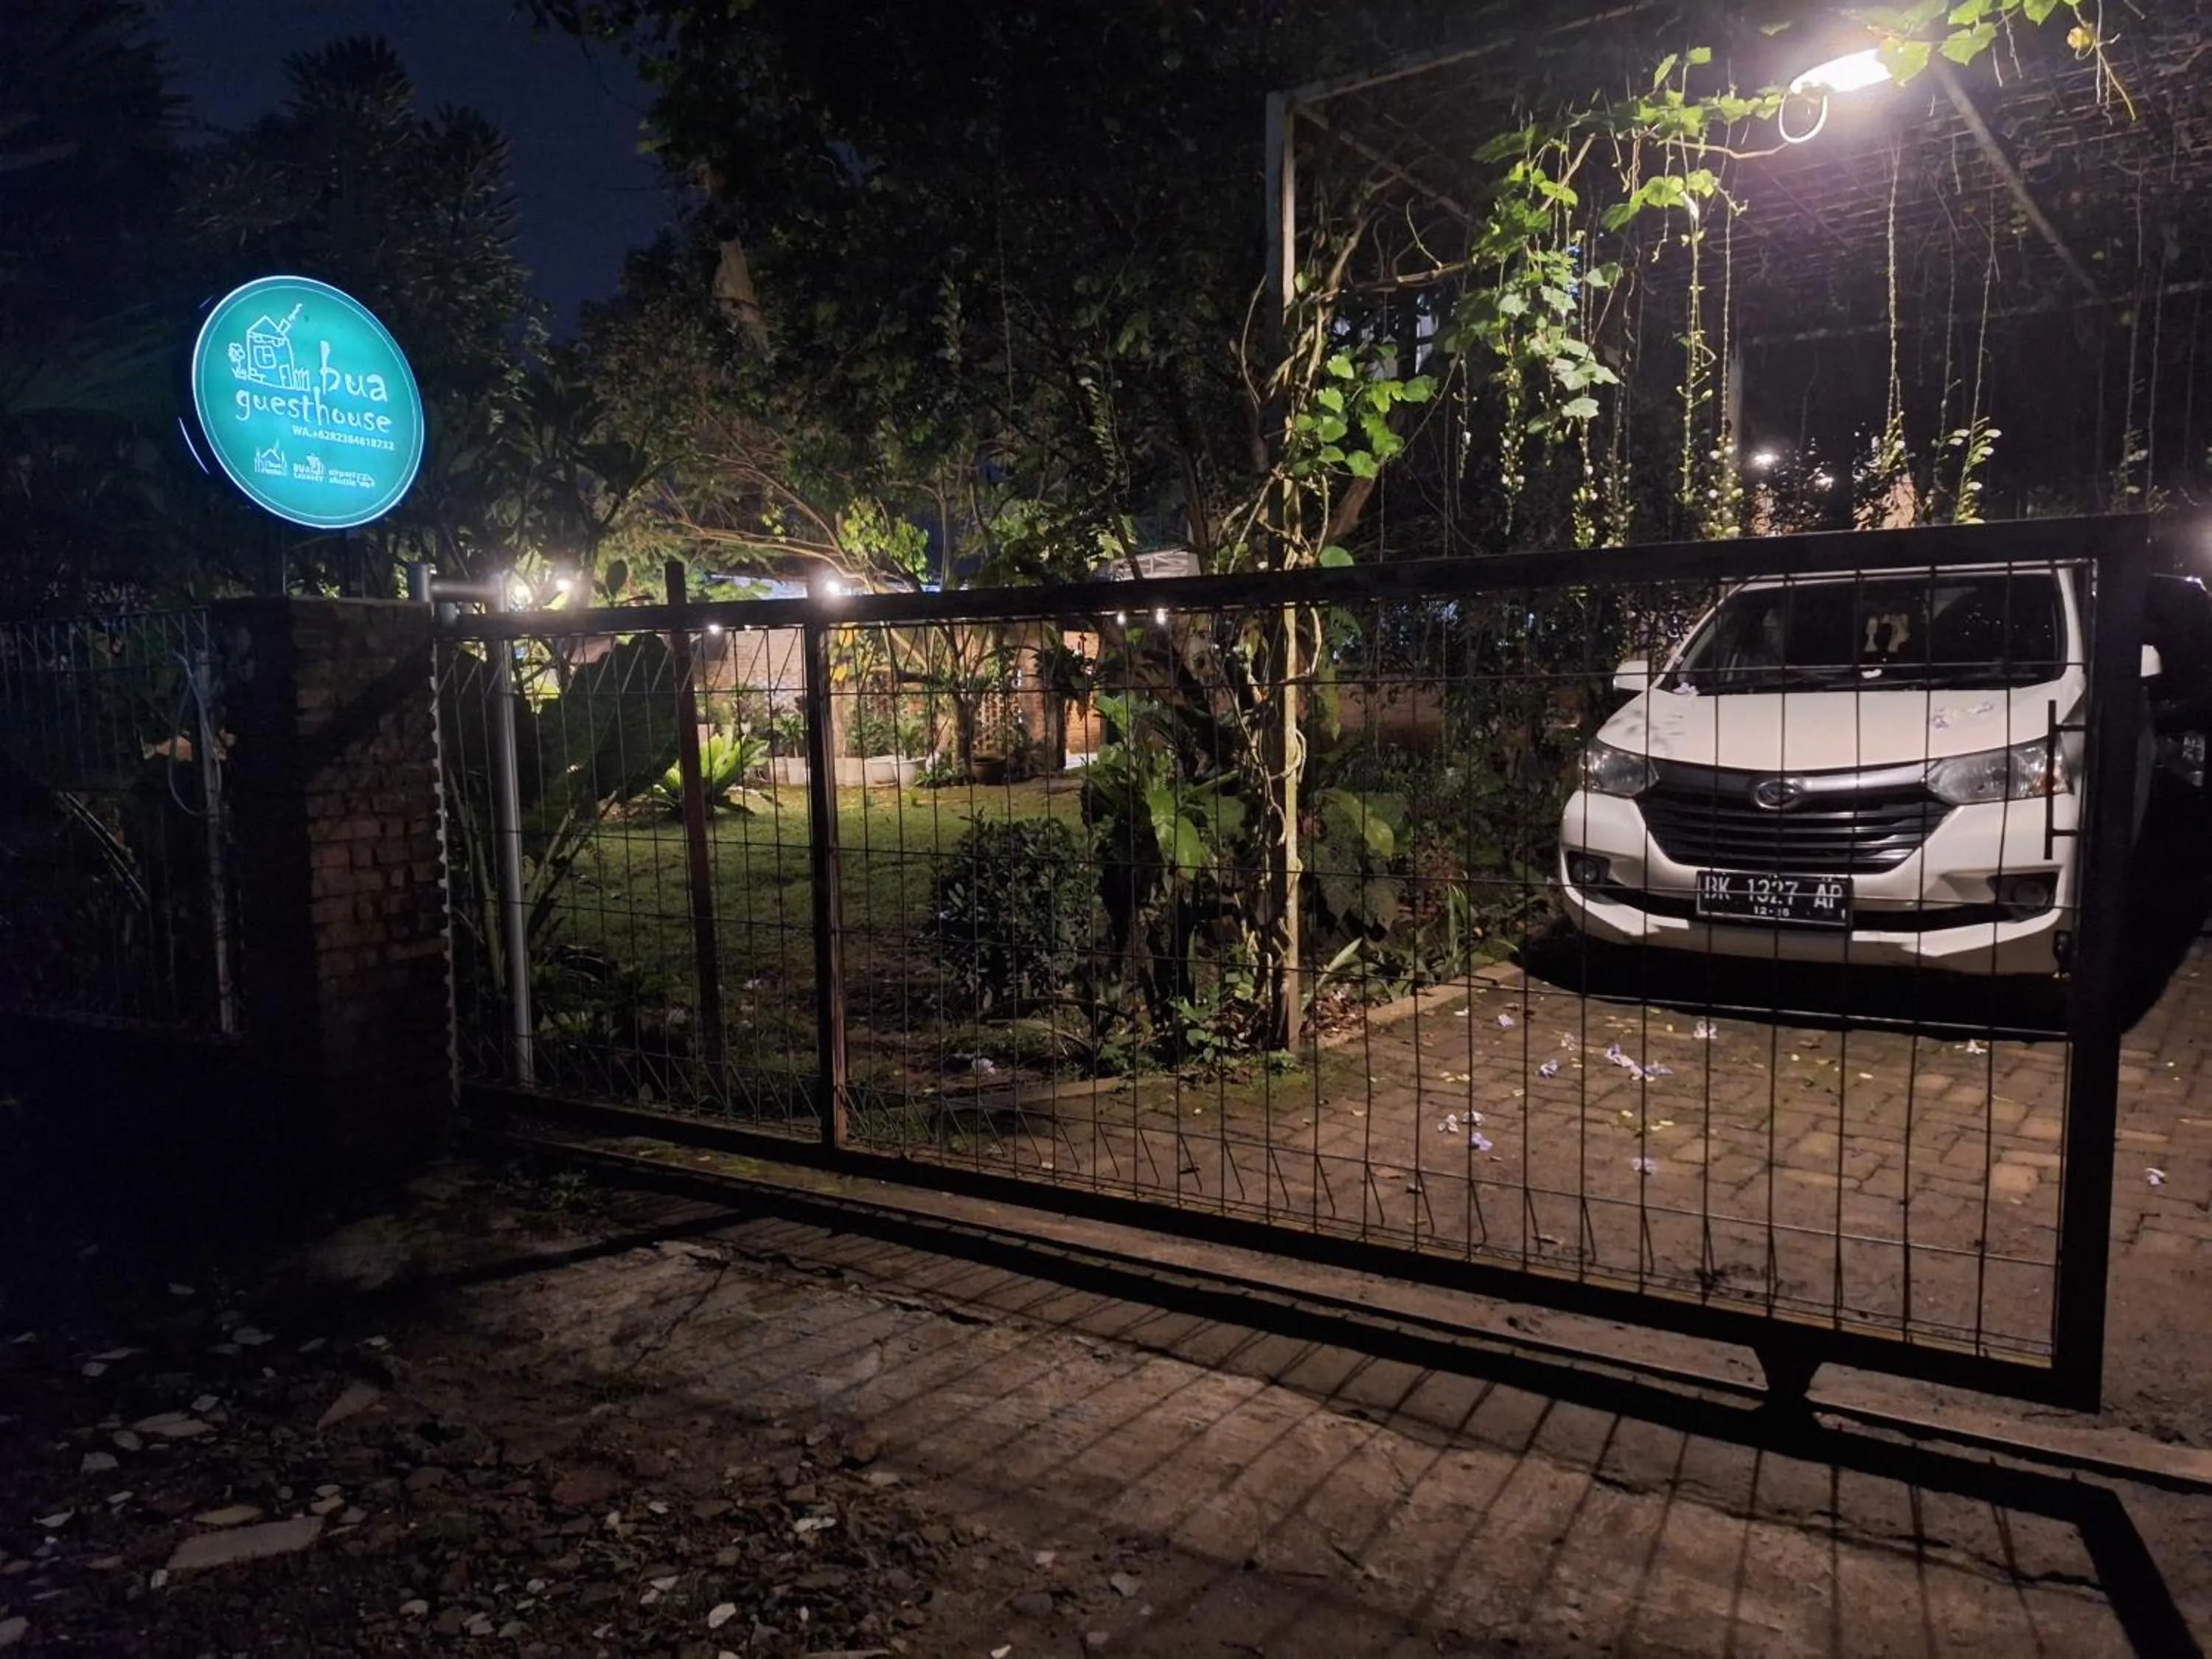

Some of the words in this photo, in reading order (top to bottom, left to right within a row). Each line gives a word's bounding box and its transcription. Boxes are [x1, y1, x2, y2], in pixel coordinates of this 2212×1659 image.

[320, 340, 388, 402] bua
[235, 386, 392, 434] guesthouse
[1704, 875, 1731, 900] BK
[1747, 878, 1799, 905] 1327
[1813, 883, 1843, 909] AP
